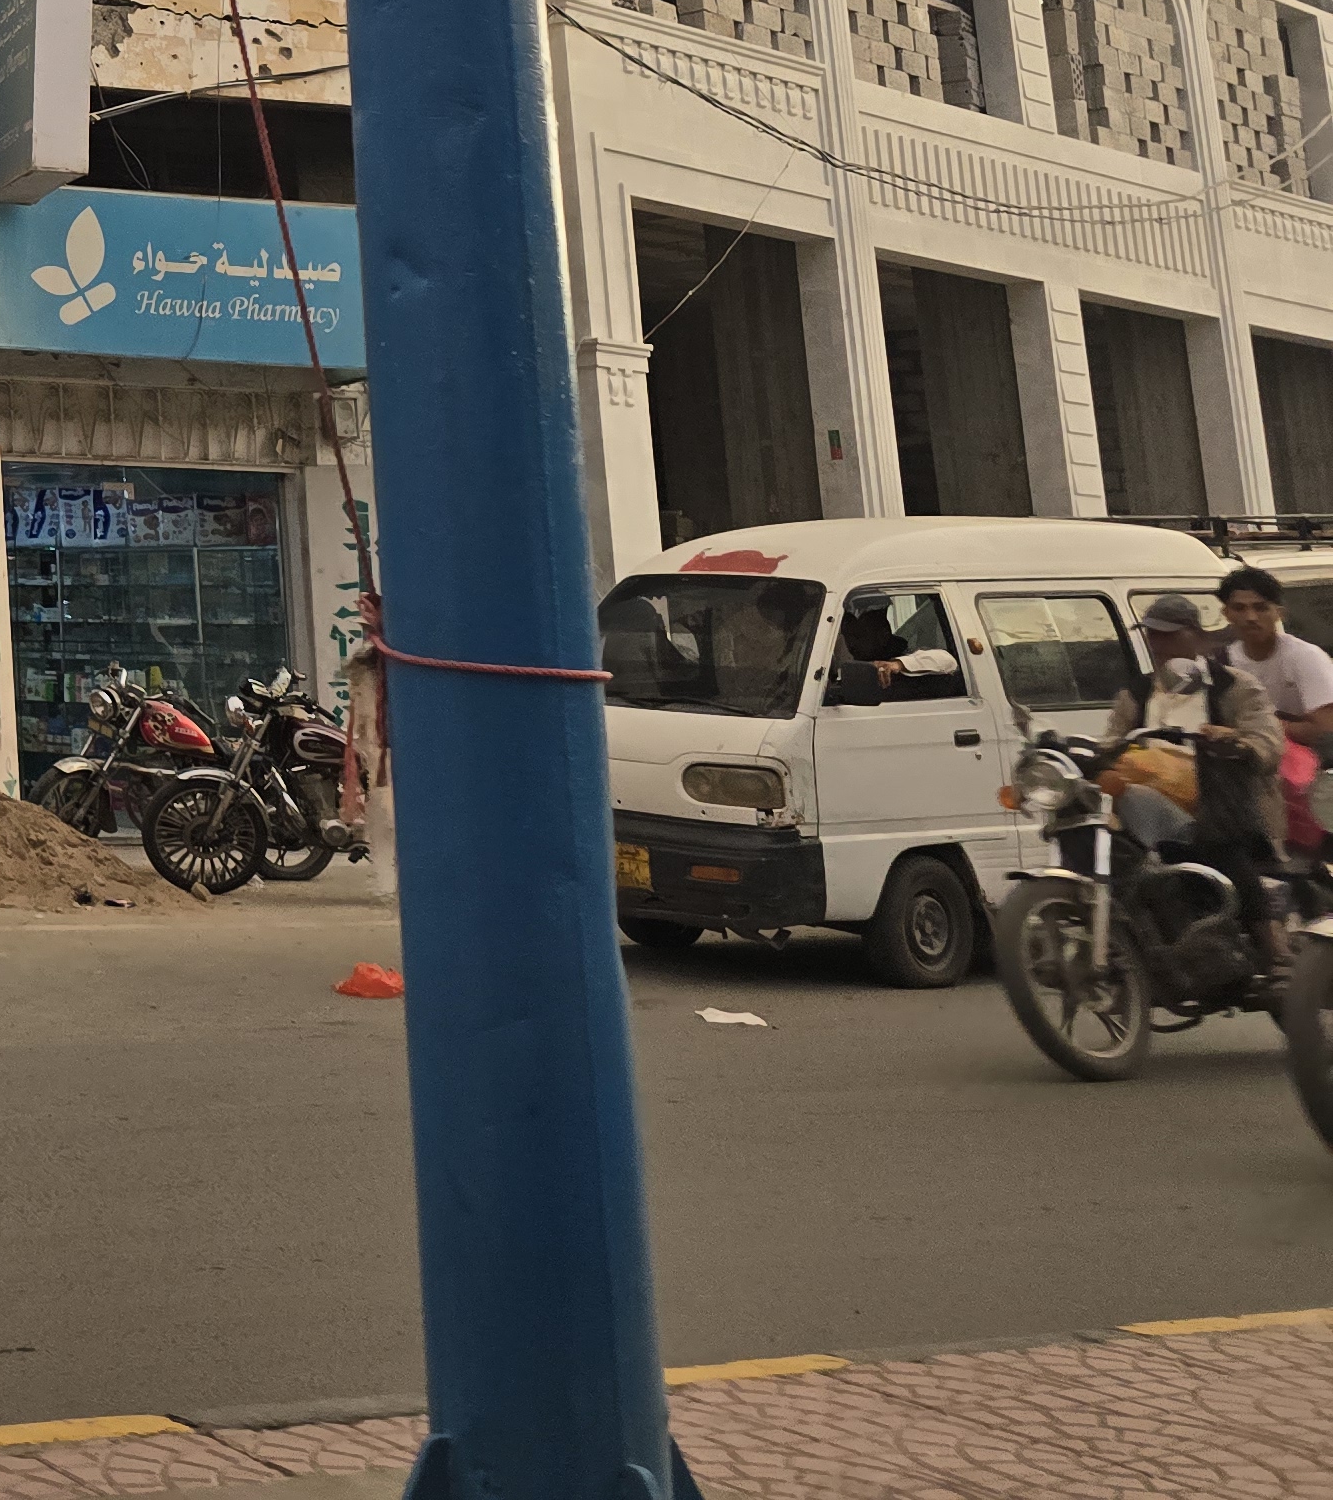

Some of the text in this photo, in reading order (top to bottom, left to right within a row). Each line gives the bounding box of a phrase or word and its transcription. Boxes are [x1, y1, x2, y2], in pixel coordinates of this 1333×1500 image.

[132, 240, 342, 290] صيدلية حواء
[134, 289, 340, 333] Hawaa Pharmacy
